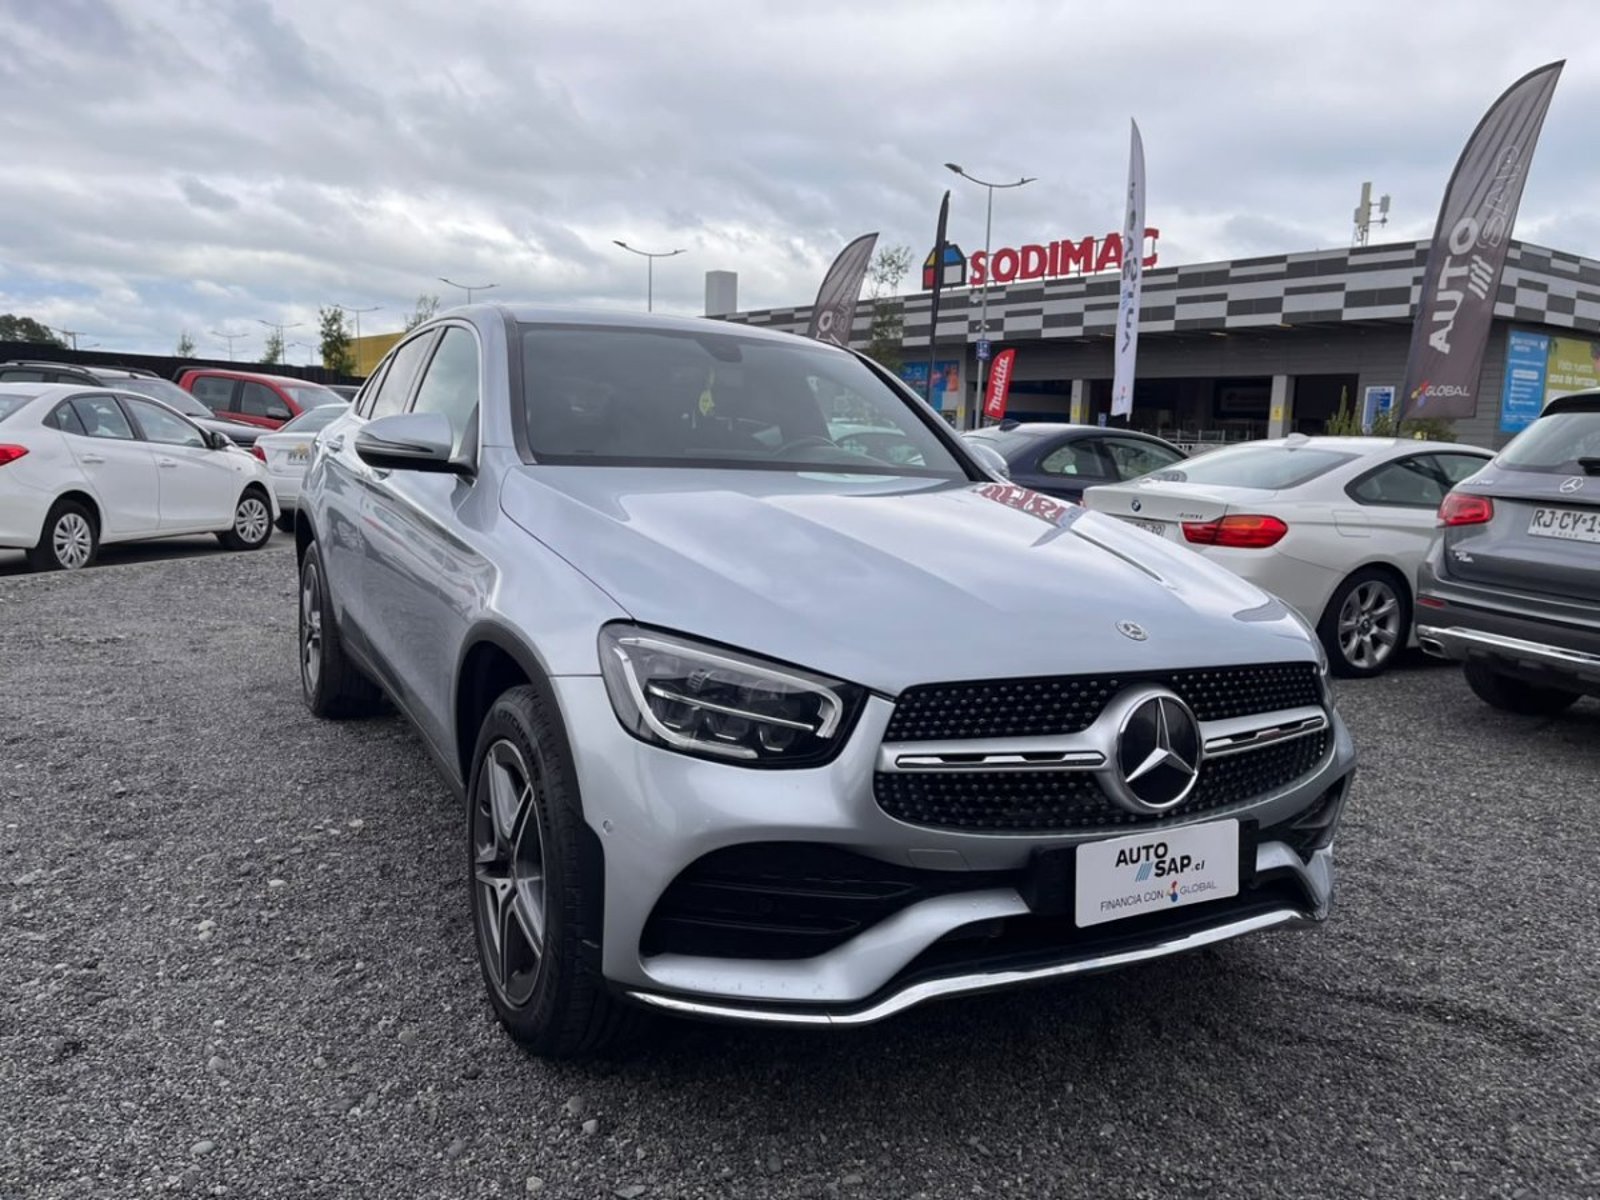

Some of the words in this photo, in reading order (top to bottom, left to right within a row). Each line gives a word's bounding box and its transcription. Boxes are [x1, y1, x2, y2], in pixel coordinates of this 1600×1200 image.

[969, 227, 1160, 286] SODIMAC
[1428, 216, 1480, 355] AUTO
[1424, 384, 1471, 398] GLOBAL
[1115, 841, 1169, 868] AUTO
[1100, 893, 1143, 912] FINANCIA
[1143, 890, 1164, 903] CON
[1179, 880, 1217, 896] GLOBAL
